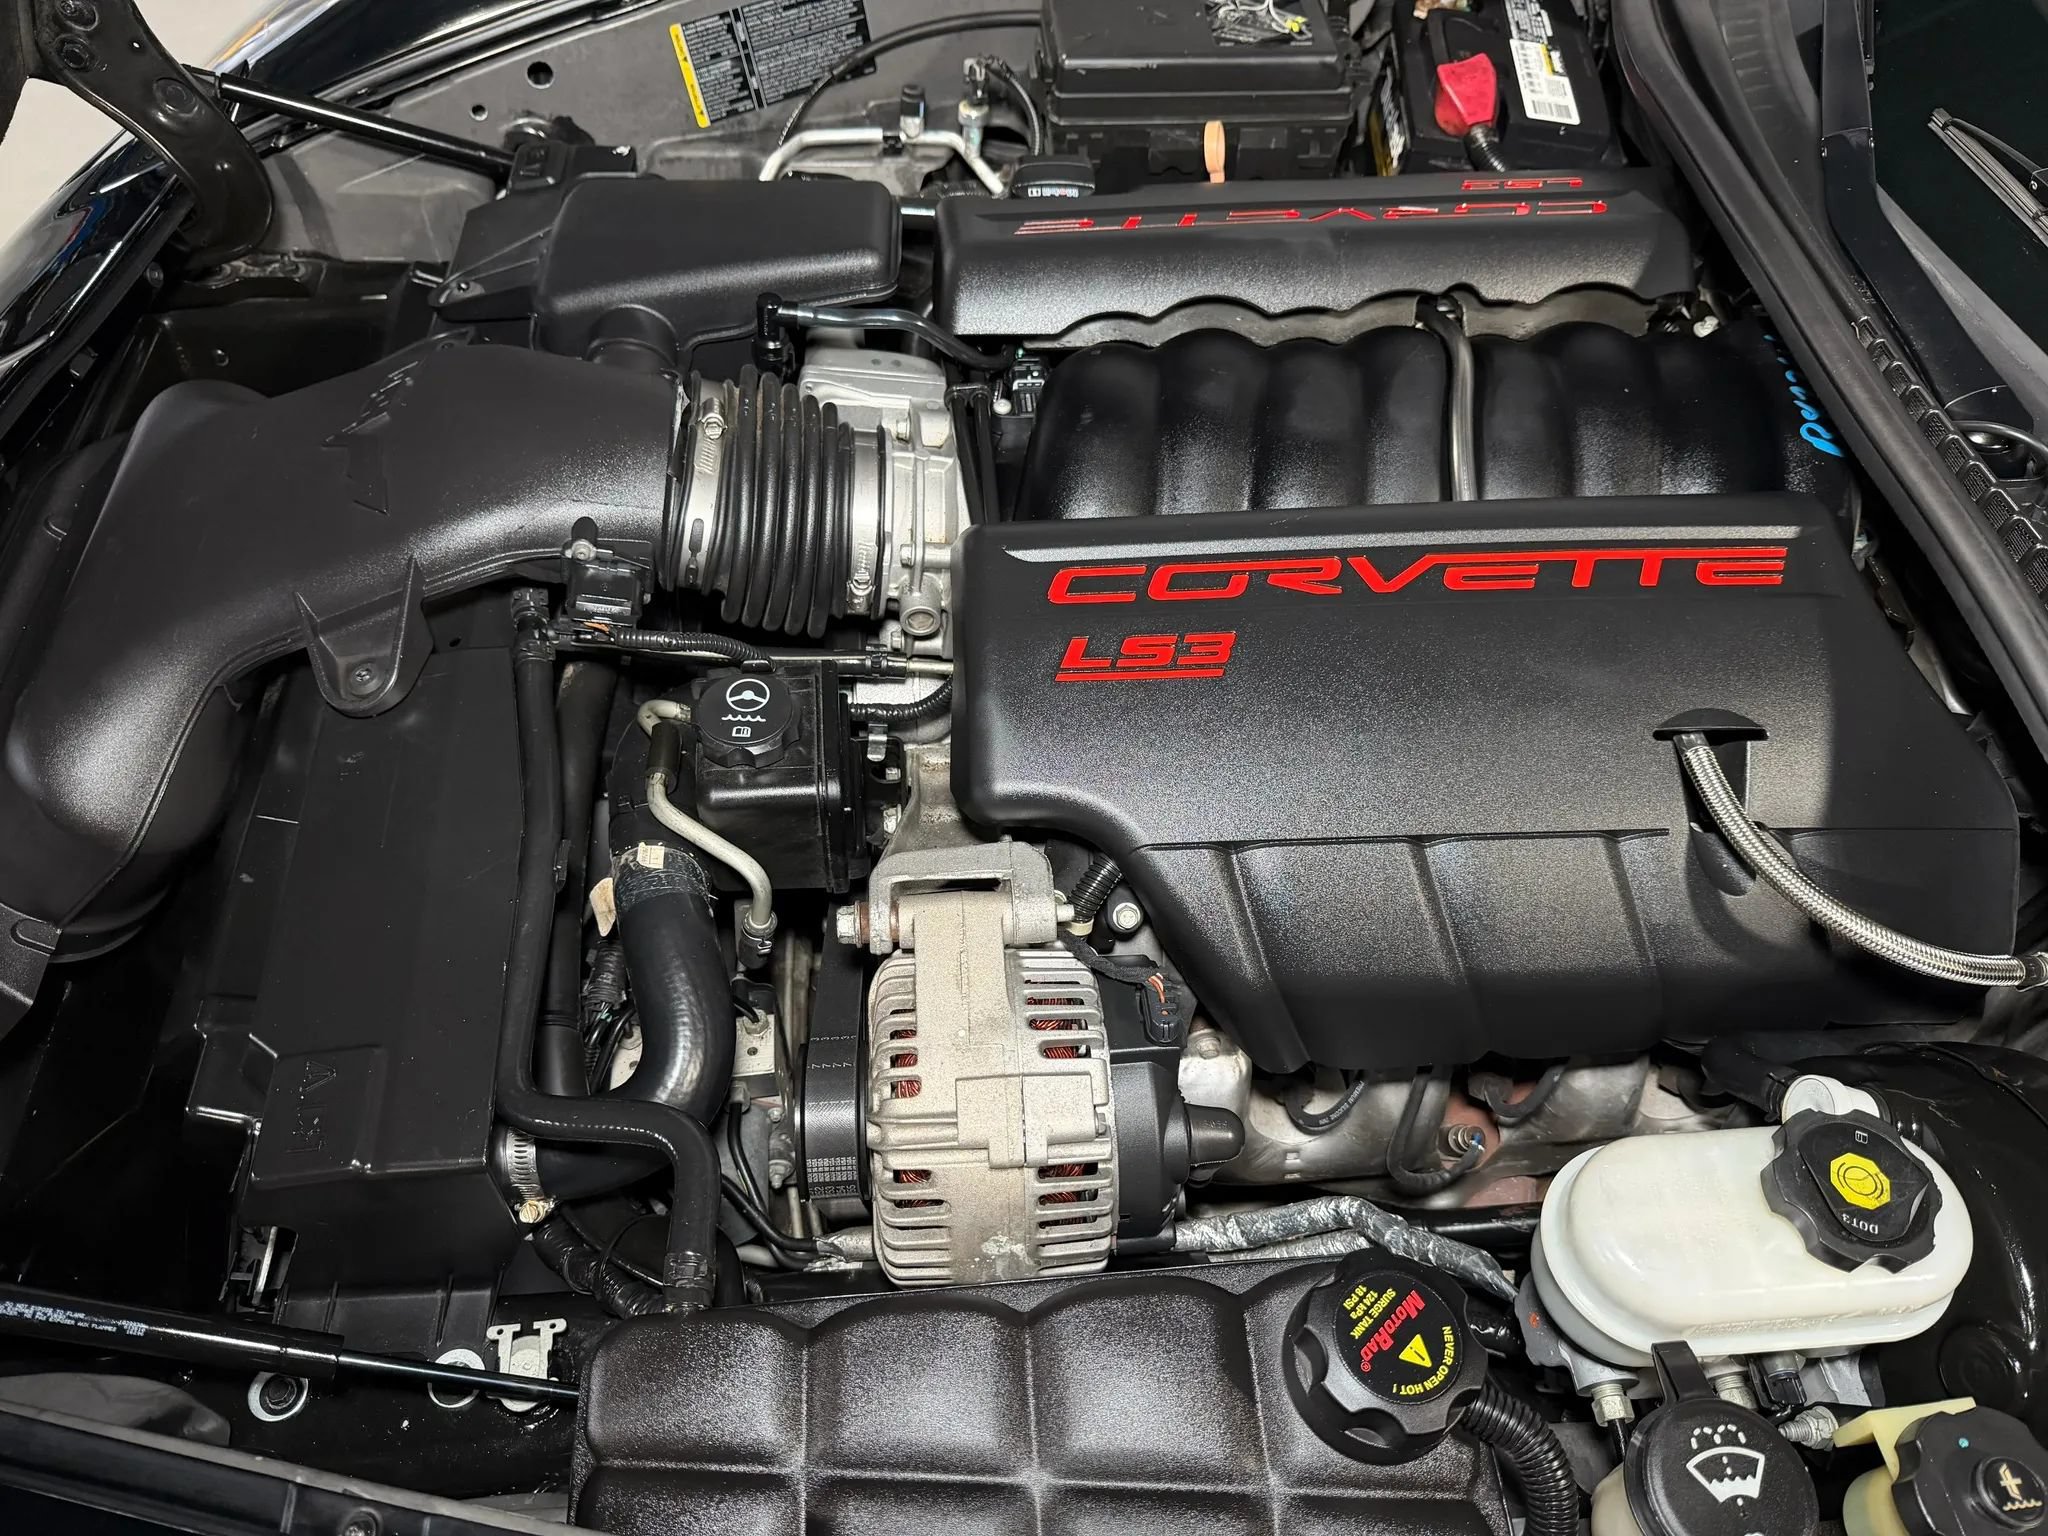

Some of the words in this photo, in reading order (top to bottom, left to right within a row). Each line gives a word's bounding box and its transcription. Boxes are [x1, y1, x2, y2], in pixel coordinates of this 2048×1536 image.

[1048, 545, 1788, 604] CORVETTE
[1056, 631, 1238, 680] LS3
[1842, 1213, 1879, 1235] DOT3
[1342, 1293, 1360, 1310] PSI
[1355, 1284, 1368, 1296] 18
[1362, 1290, 1379, 1306] 124
[1349, 1303, 1367, 1320] kPa
[1368, 1287, 1397, 1318] SURGE
[1349, 1315, 1375, 1340] TANK
[1441, 1325, 1455, 1366] NEVER
[1399, 1383, 1425, 1396] HOT
[1423, 1365, 1449, 1391] OPEN
